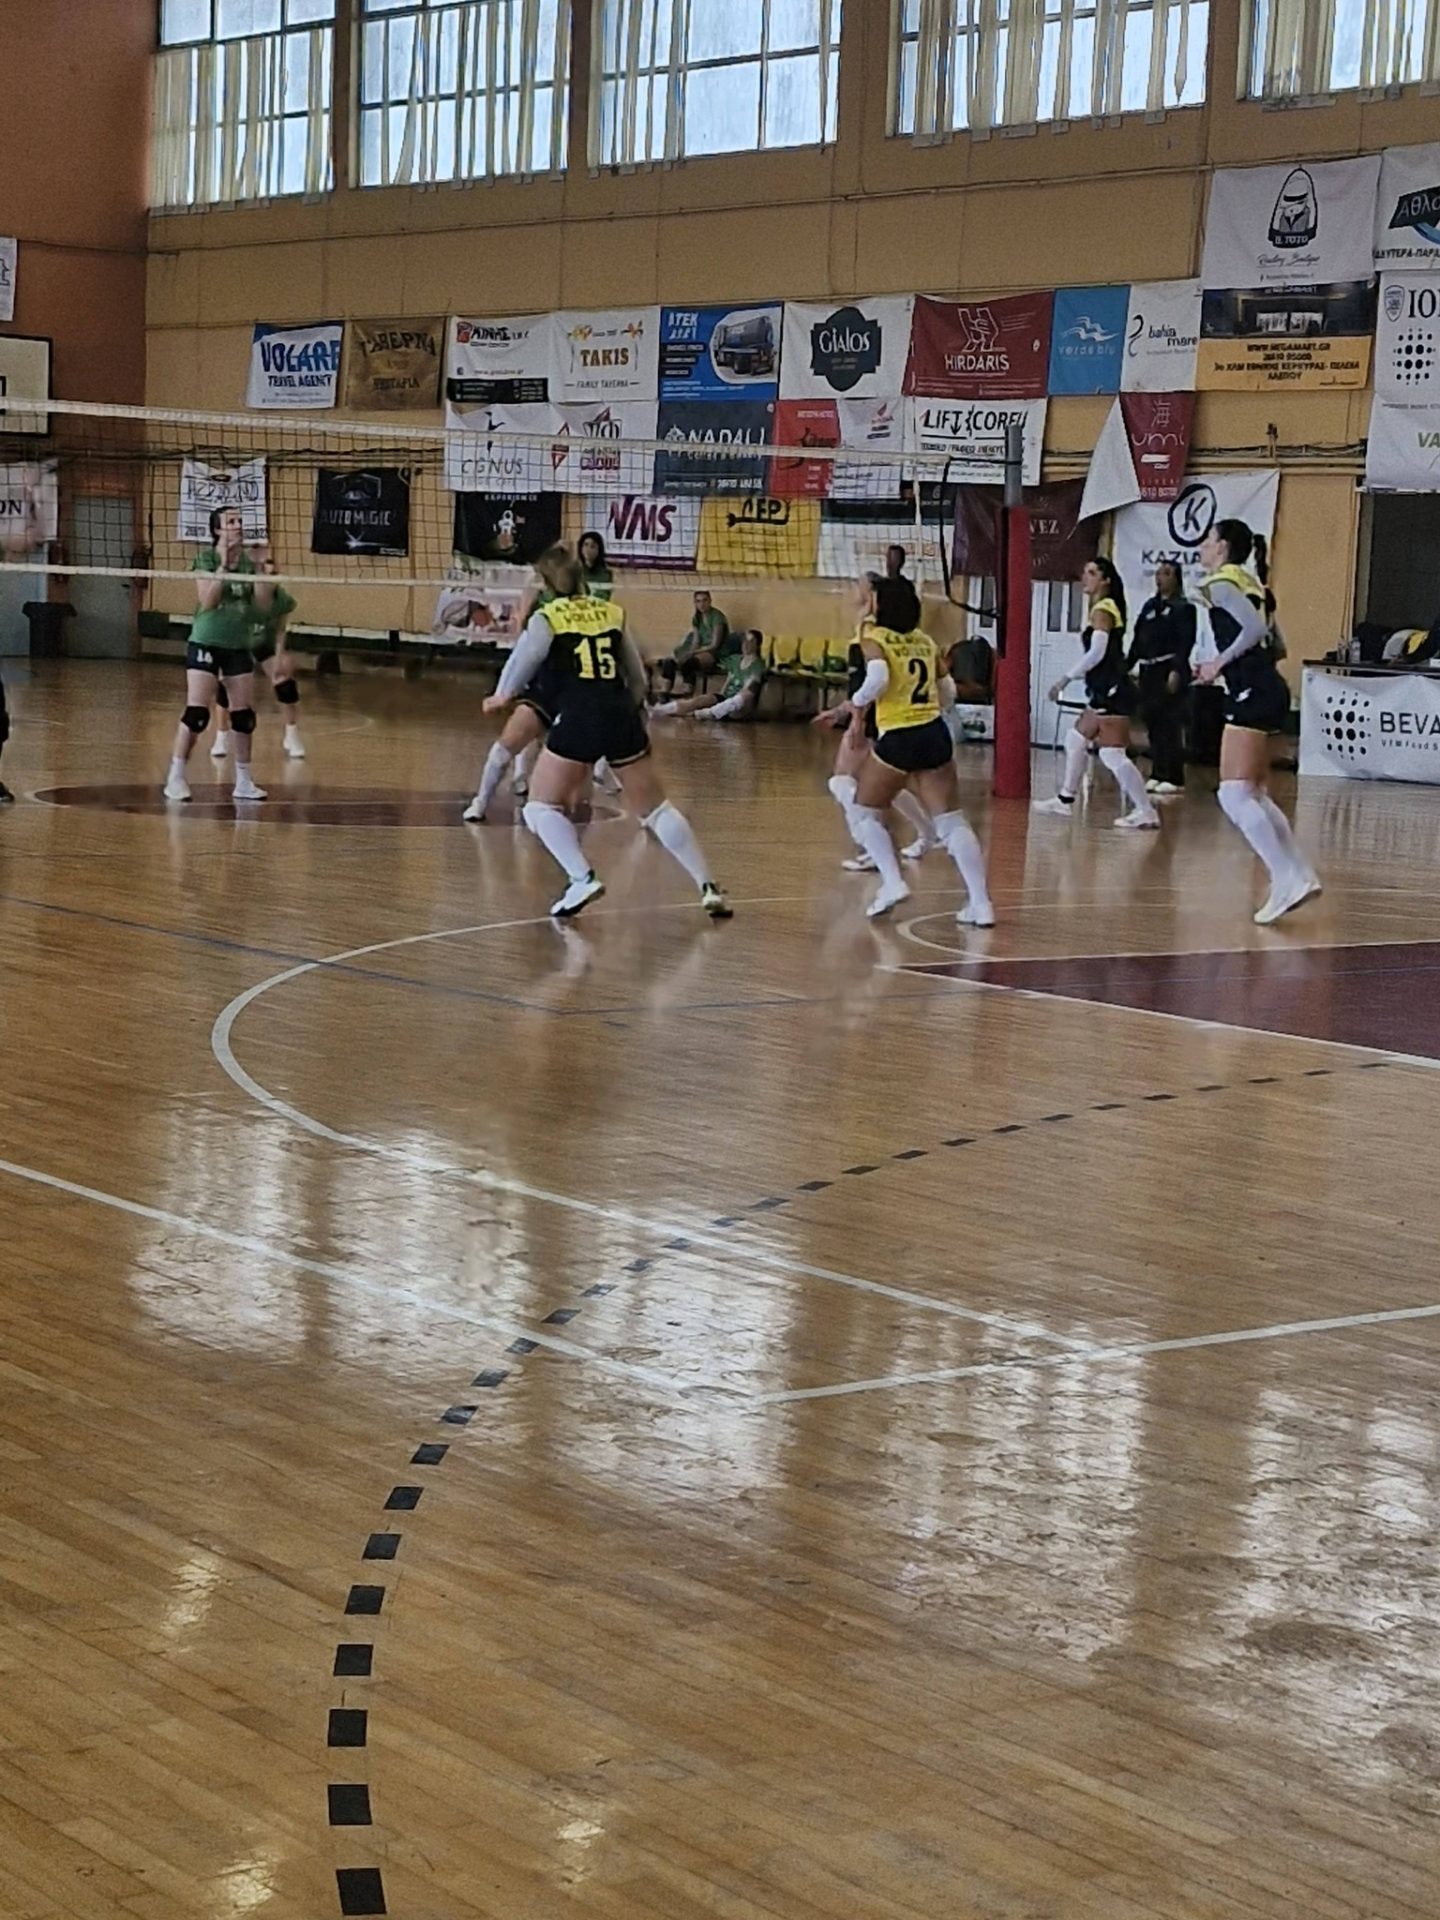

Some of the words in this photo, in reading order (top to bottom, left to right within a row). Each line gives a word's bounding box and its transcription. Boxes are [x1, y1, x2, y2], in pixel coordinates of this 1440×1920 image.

[1408, 288, 1440, 319] IO
[580, 348, 629, 367] TAKIS
[945, 354, 1010, 371] HIRDARIS
[1131, 427, 1184, 446] umi
[1183, 496, 1206, 532] K
[575, 637, 617, 680] 15
[908, 658, 929, 704] 2
